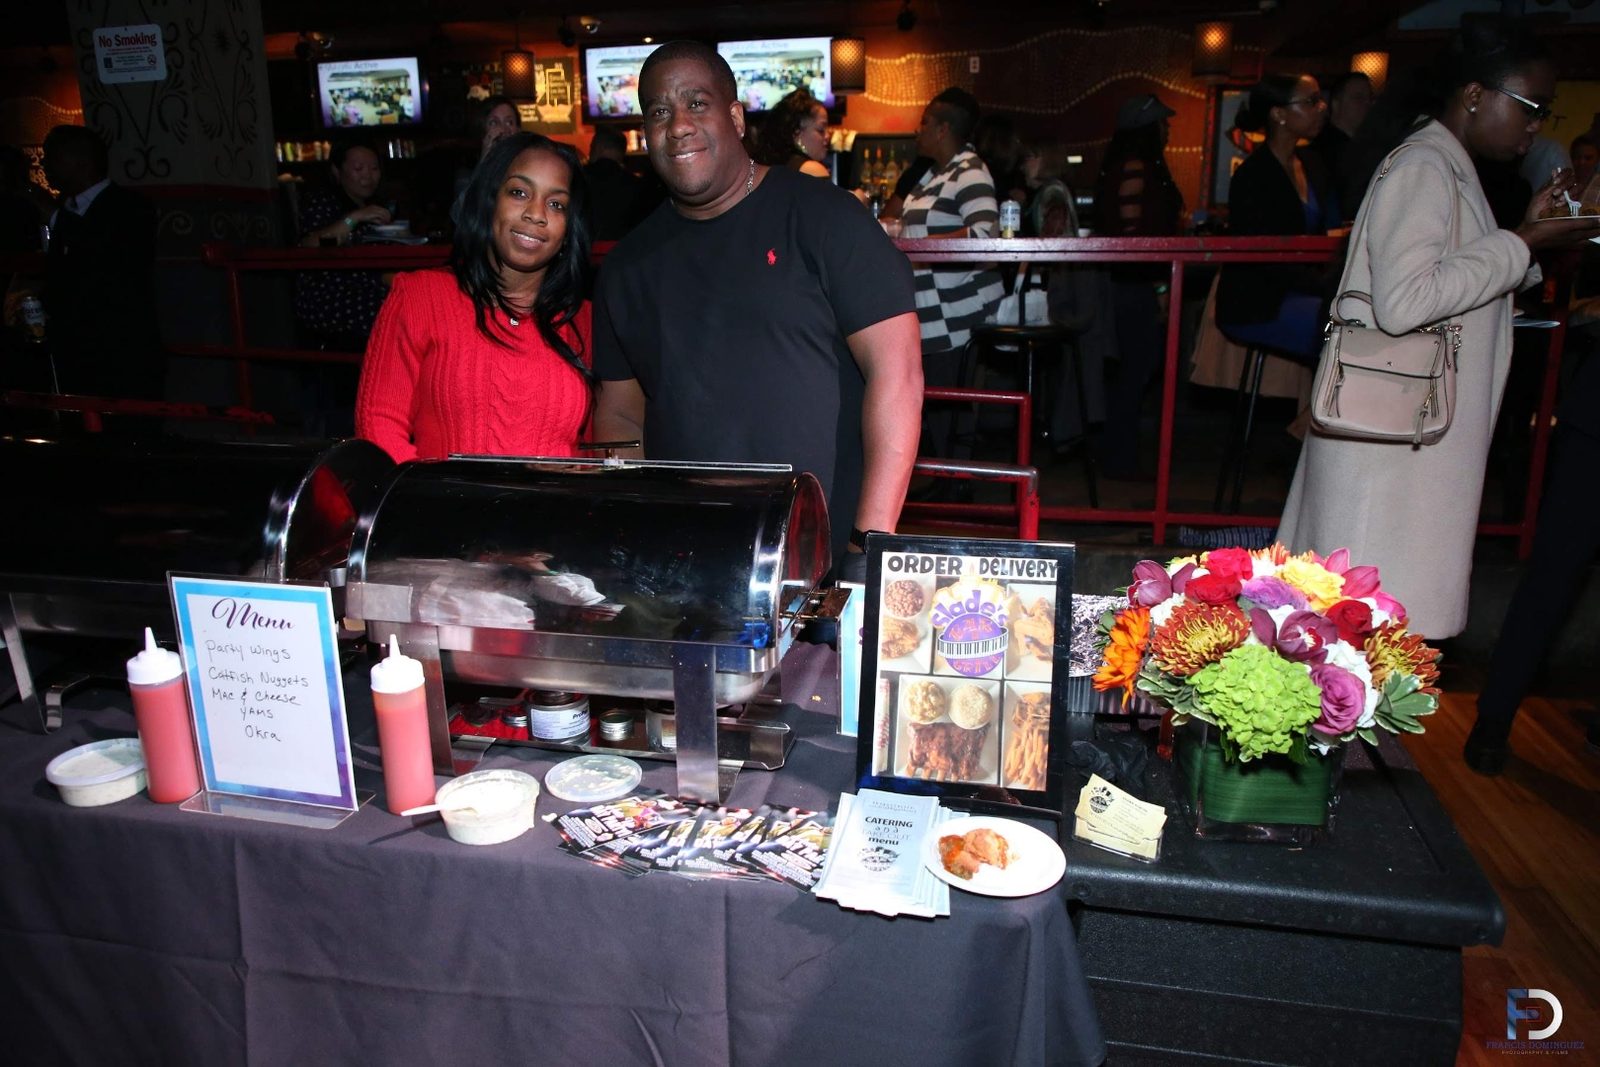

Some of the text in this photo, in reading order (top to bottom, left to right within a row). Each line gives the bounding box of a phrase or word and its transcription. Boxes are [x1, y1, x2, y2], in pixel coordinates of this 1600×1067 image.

[98, 32, 157, 48] No Smoking
[888, 555, 963, 576] ORDER
[211, 597, 295, 629] Menu
[205, 640, 244, 662] Party
[260, 671, 309, 688] Nuggets
[245, 725, 281, 742] Okra
[865, 816, 914, 828] CATERING
[868, 837, 899, 845] menu
